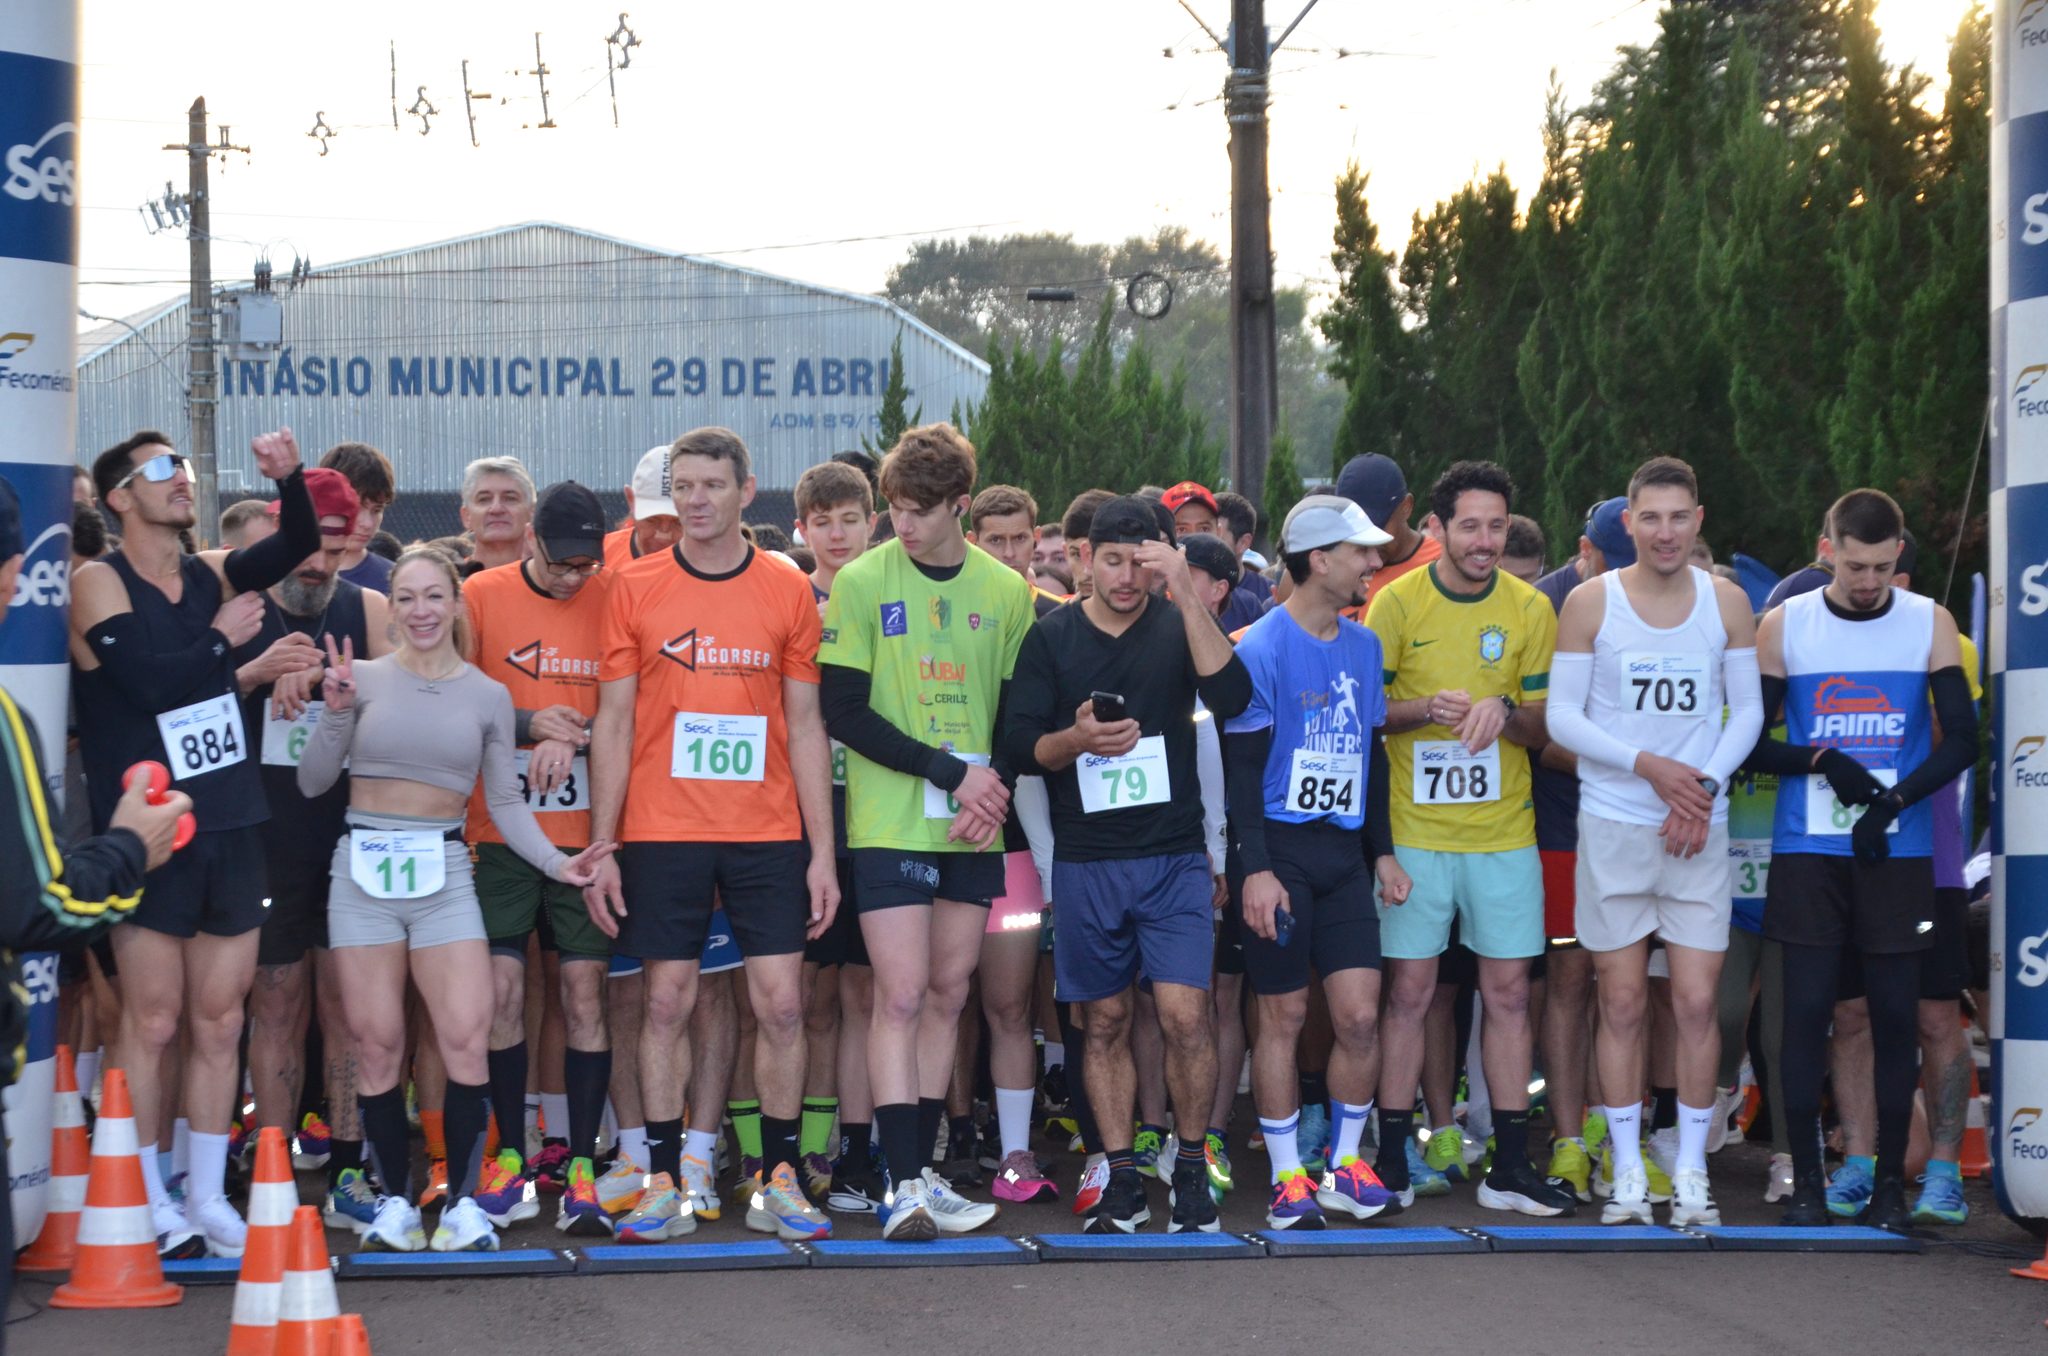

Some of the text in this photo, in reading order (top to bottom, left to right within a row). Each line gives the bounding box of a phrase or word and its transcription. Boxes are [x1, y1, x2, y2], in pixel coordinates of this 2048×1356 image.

[222, 345, 915, 398] INÁSIO MUNICIPAL 29 DE ABRI
[1631, 677, 1697, 711] 703
[1809, 712, 1906, 739] JAIME
[181, 722, 239, 770] 884
[687, 737, 753, 775] 160
[1101, 767, 1148, 804] 79
[1297, 776, 1353, 812] 854
[1424, 764, 1488, 799] 708
[376, 856, 416, 892] 11
